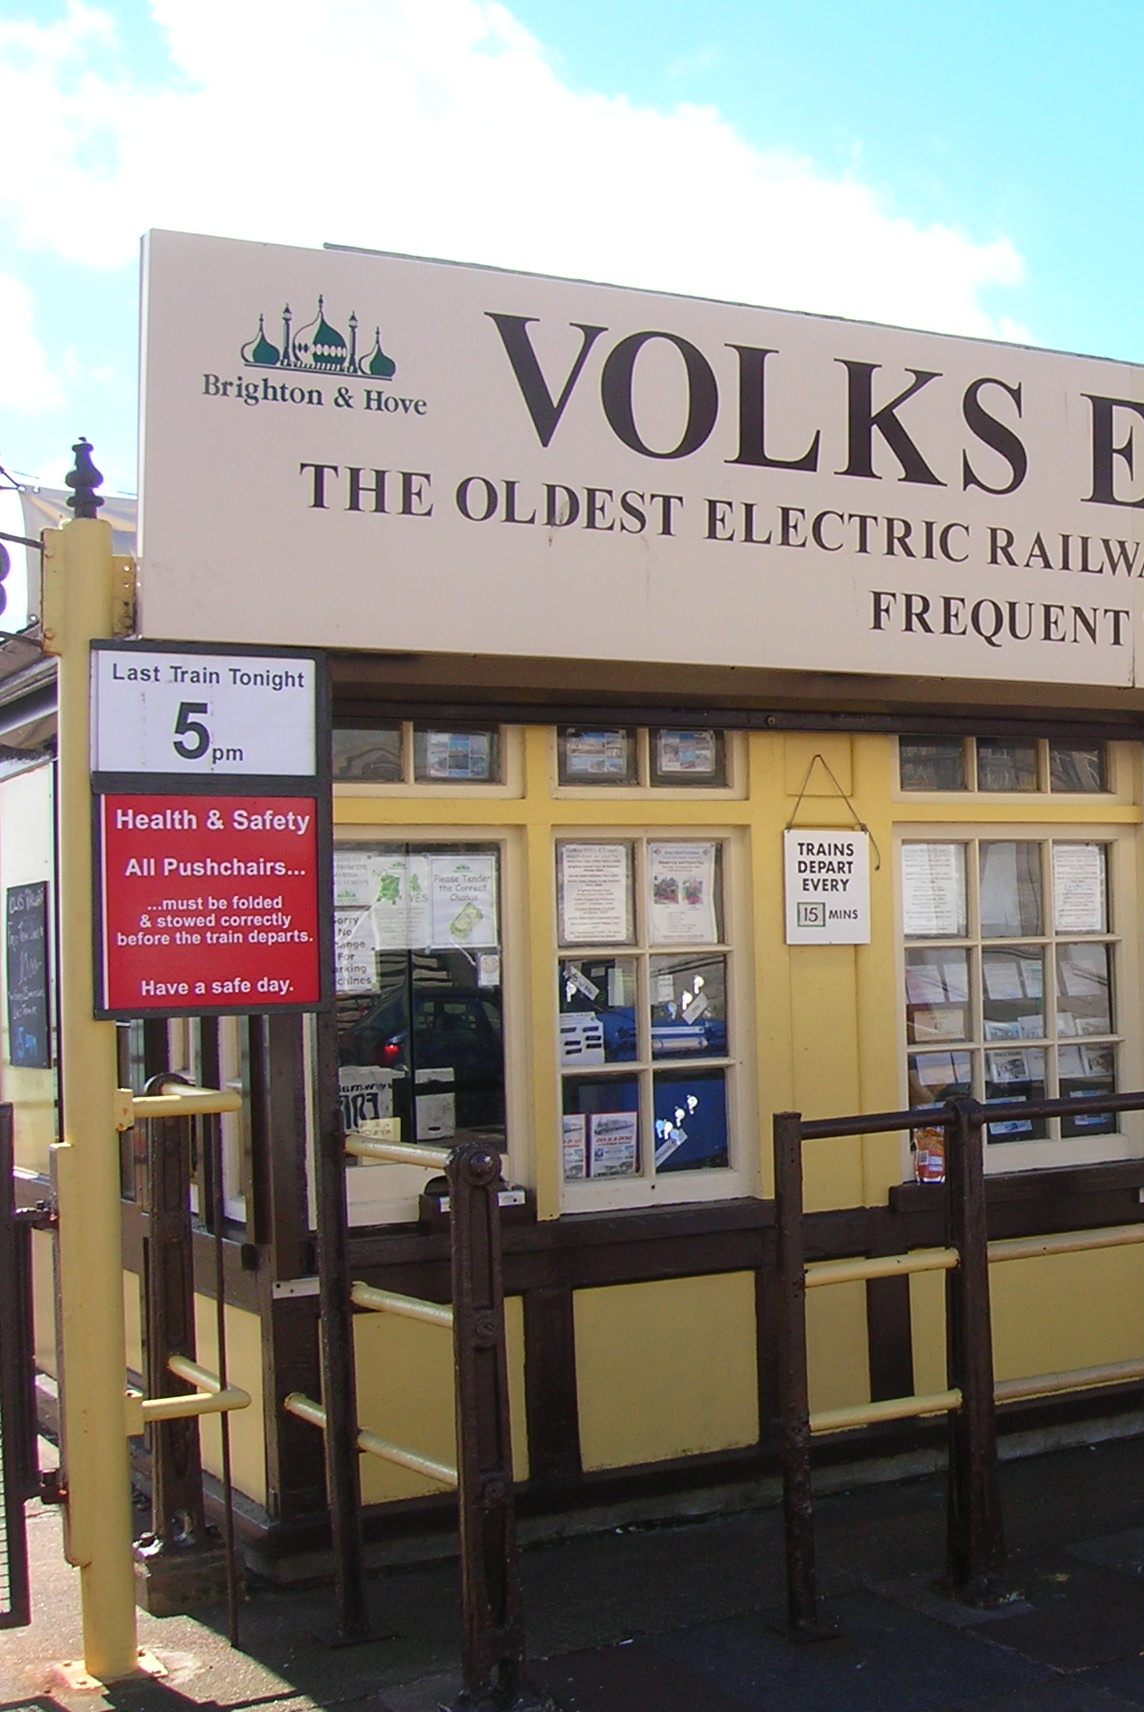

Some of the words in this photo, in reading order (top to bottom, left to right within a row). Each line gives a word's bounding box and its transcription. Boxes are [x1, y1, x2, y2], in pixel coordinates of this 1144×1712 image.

[202, 373, 324, 408] Brighton
[333, 387, 355, 409] &
[364, 389, 428, 416] Hove
[484, 311, 1029, 496] VOLKS
[300, 462, 435, 518] THE
[455, 475, 685, 537] OLDEST
[703, 498, 971, 563] ELECTRIC
[869, 589, 1131, 648] FREQUENT
[112, 662, 161, 683] Last
[169, 665, 221, 685] Train
[228, 668, 305, 691] Tonight
[115, 808, 198, 831] Health
[206, 809, 224, 830] &
[232, 809, 311, 835] Safety
[797, 842, 854, 857] TRAINS
[124, 858, 156, 877] All
[163, 857, 307, 877] Pushchairs...
[797, 860, 853, 875] DEPART
[434, 873, 458, 883] Please
[462, 874, 492, 884] Tender
[802, 878, 850, 892] EVERY
[408, 893, 428, 903] YES
[438, 884, 453, 893] the
[455, 884, 487, 893] Correct
[146, 896, 204, 911] ...must
[208, 895, 228, 910] be
[232, 894, 283, 910] folded
[139, 914, 153, 928] &
[156, 913, 216, 928] stowed
[220, 912, 292, 931] correctly
[804, 907, 818, 923] 15
[829, 909, 858, 920] MINS
[116, 931, 171, 947] before
[174, 930, 202, 945] the
[205, 929, 244, 945] train
[248, 928, 314, 947] departs.
[338, 951, 356, 961] For
[141, 979, 190, 997] Have
[194, 982, 206, 995] a
[211, 977, 252, 995] safe
[256, 976, 295, 997] day.
